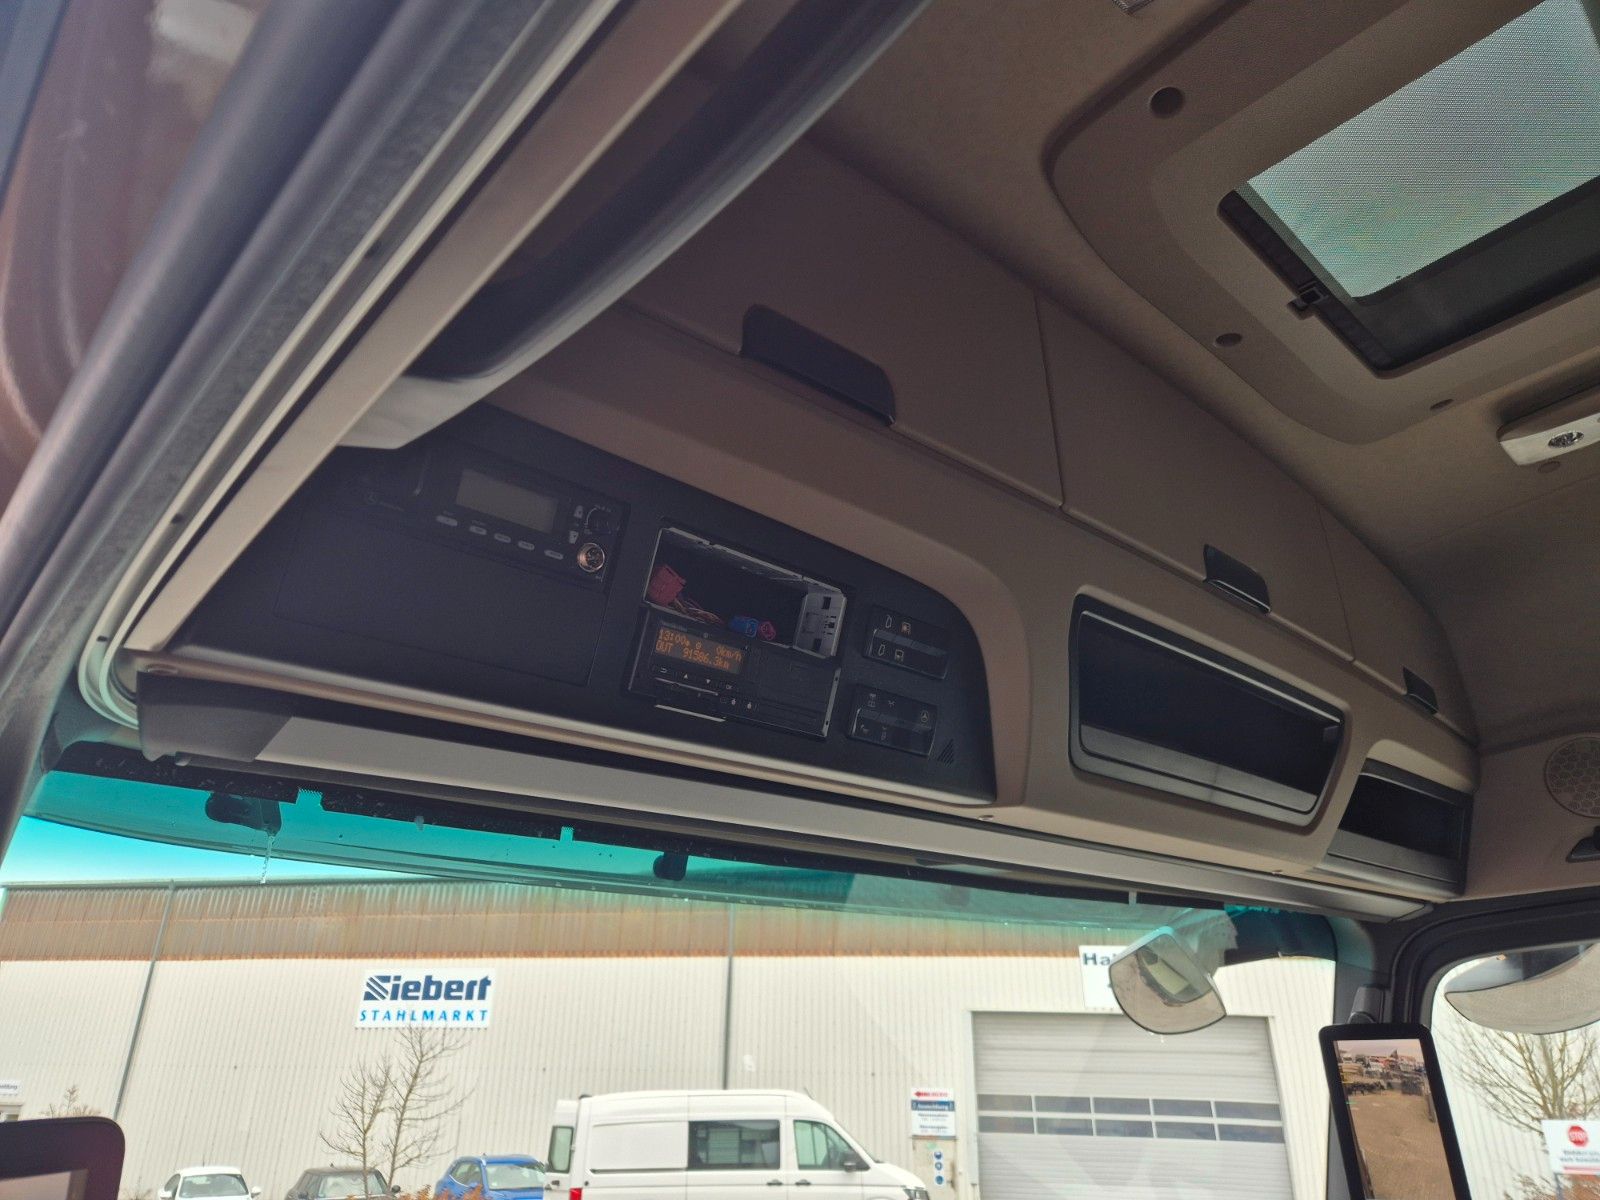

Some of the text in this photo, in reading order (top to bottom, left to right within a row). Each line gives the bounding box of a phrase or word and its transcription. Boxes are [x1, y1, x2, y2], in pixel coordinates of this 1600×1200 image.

[1084, 953, 1116, 965] Ha
[363, 975, 492, 1001] Siebert
[359, 1009, 488, 1022] STAHLMARKT
